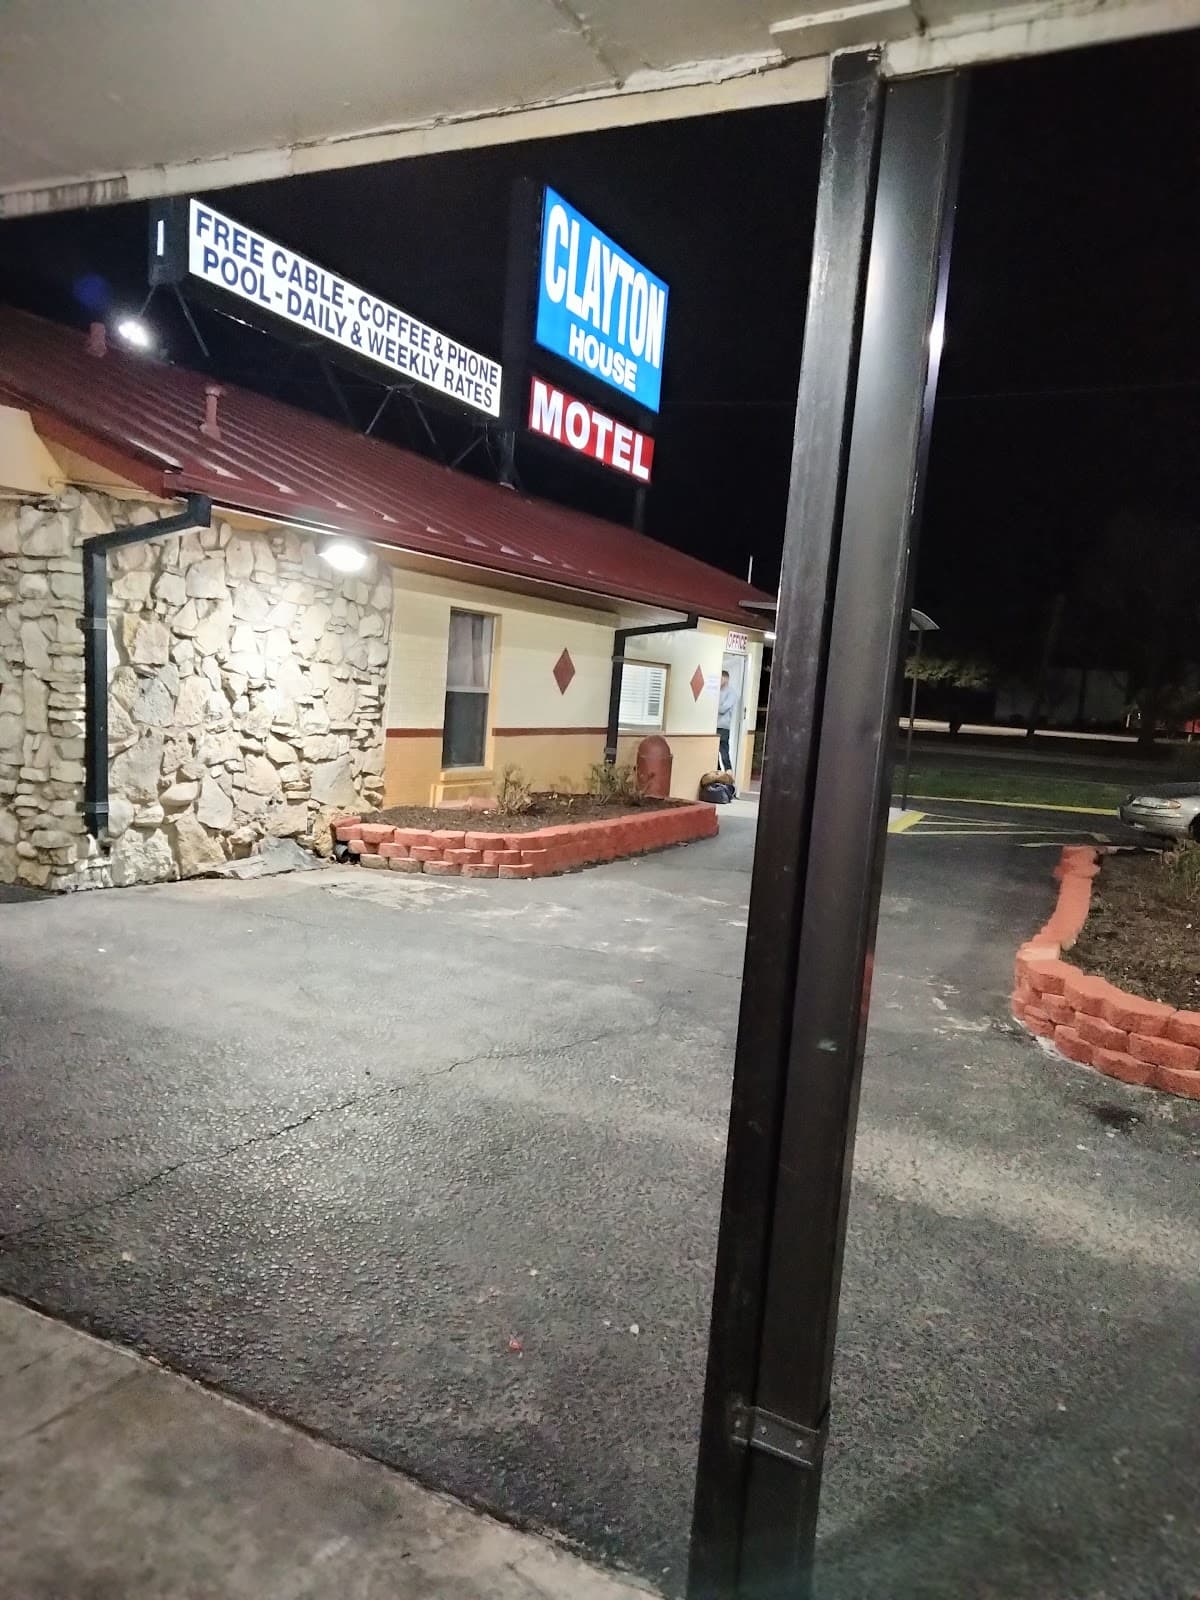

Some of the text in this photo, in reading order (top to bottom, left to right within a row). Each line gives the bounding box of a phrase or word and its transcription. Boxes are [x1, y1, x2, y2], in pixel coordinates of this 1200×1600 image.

[195, 207, 265, 268] FREE
[434, 336, 444, 360] &
[447, 343, 498, 387] PHONE
[545, 204, 665, 369] CLAYTON
[350, 321, 362, 347] &
[368, 327, 439, 382] WEEKLY
[444, 367, 493, 409] RATES
[568, 323, 638, 393] HOUSE
[531, 380, 650, 481] MOTEL
[727, 632, 748, 650] OFFICE
